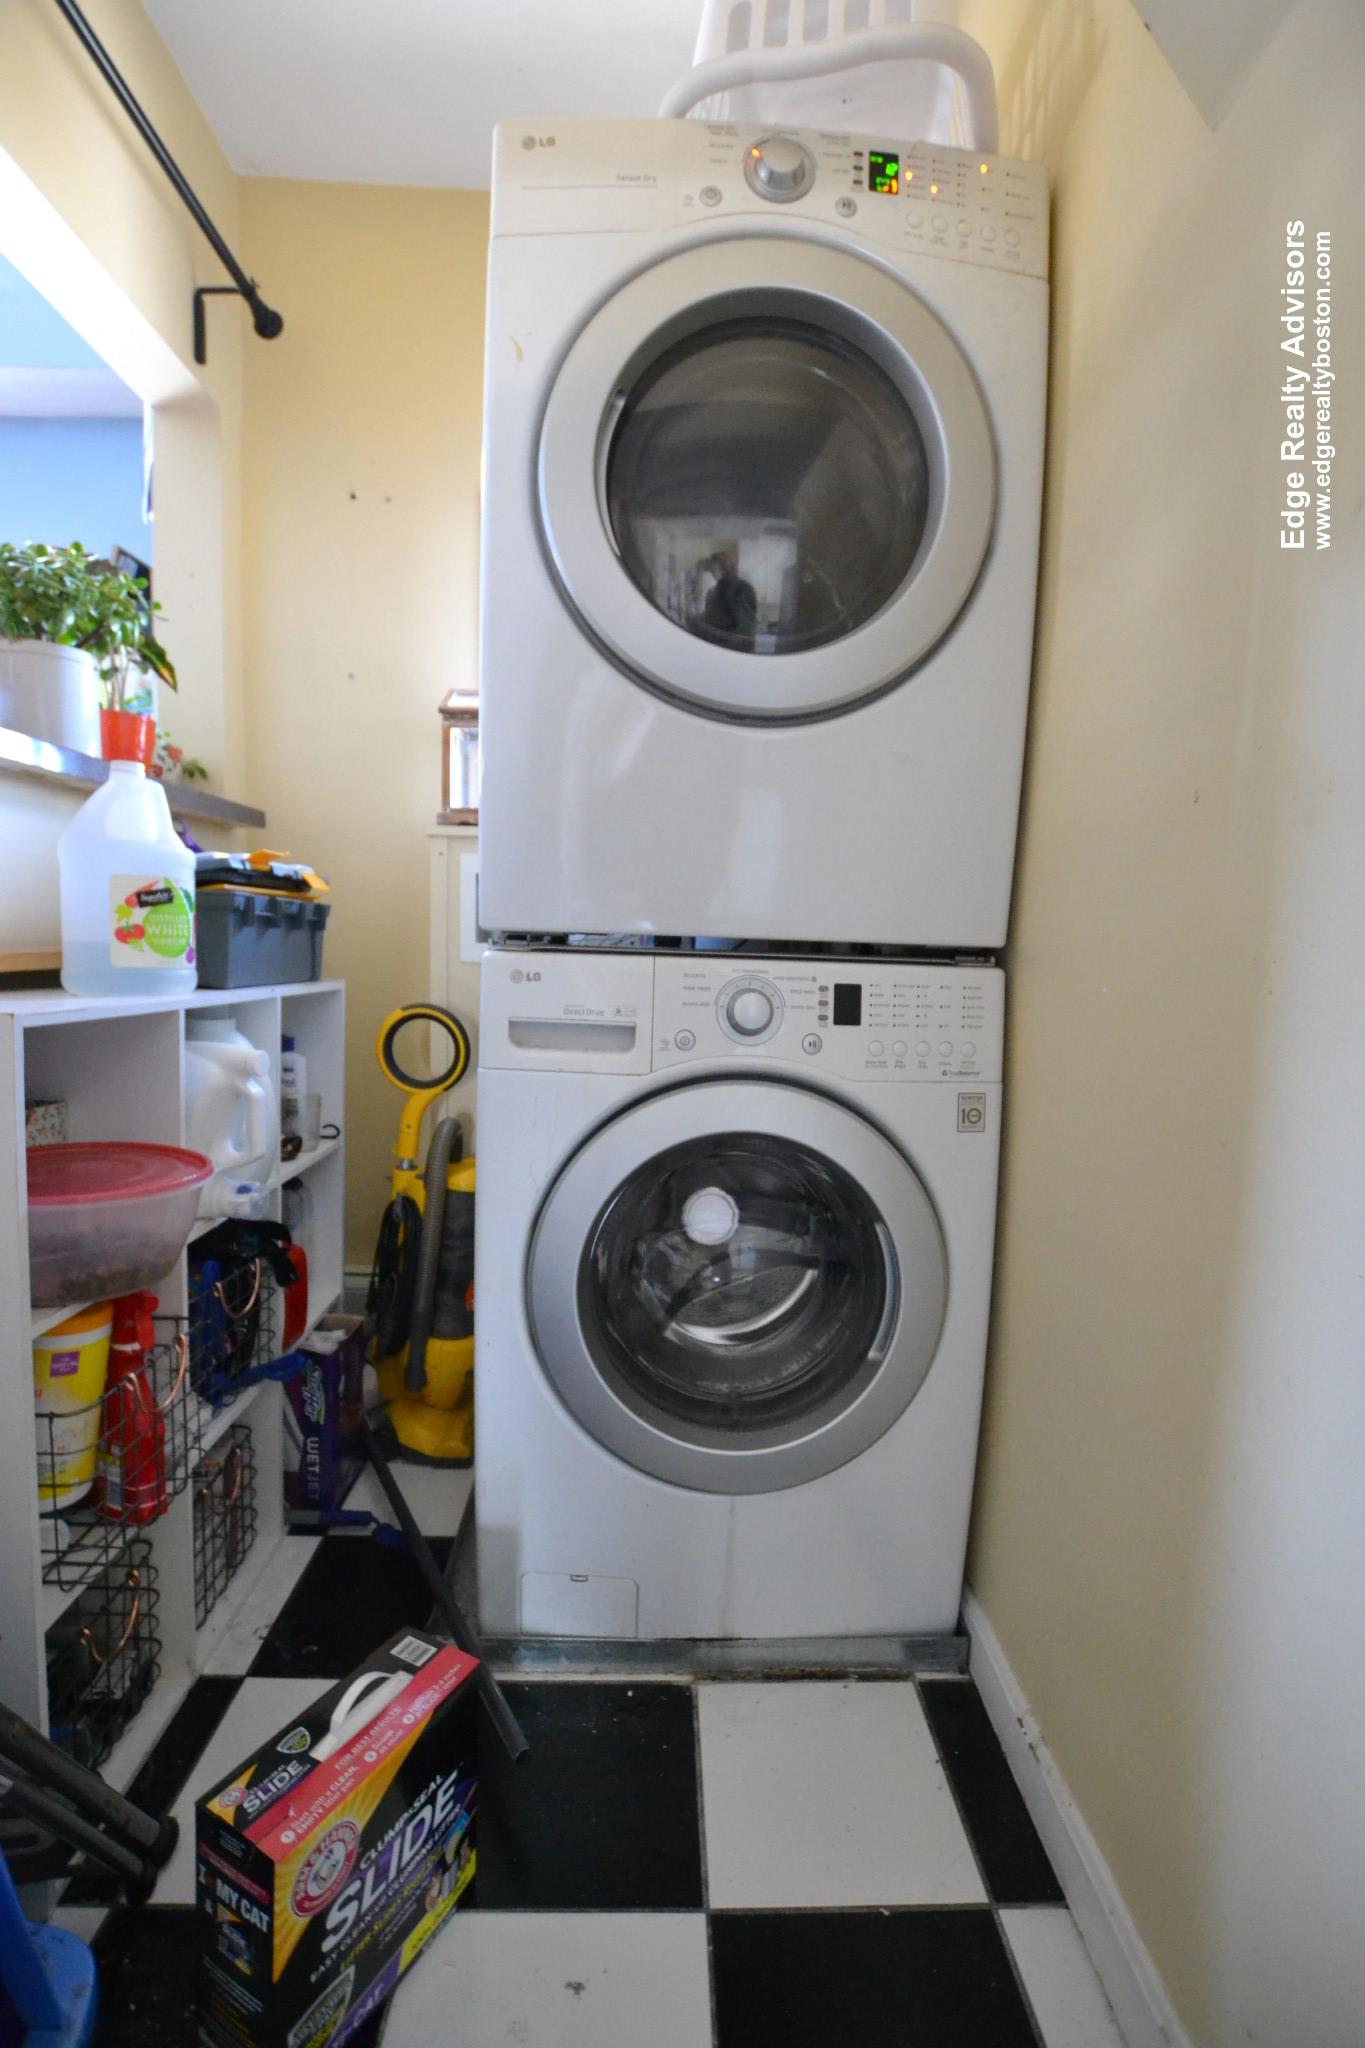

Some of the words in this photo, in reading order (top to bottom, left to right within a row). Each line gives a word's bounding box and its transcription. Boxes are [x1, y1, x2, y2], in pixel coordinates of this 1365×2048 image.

[538, 136, 556, 148] LG
[525, 971, 542, 983] LG
[243, 1760, 304, 1813] SLIDE
[321, 1768, 458, 1953] SLIDE
[216, 1878, 239, 1911] MY
[240, 1898, 271, 1934] CAT
